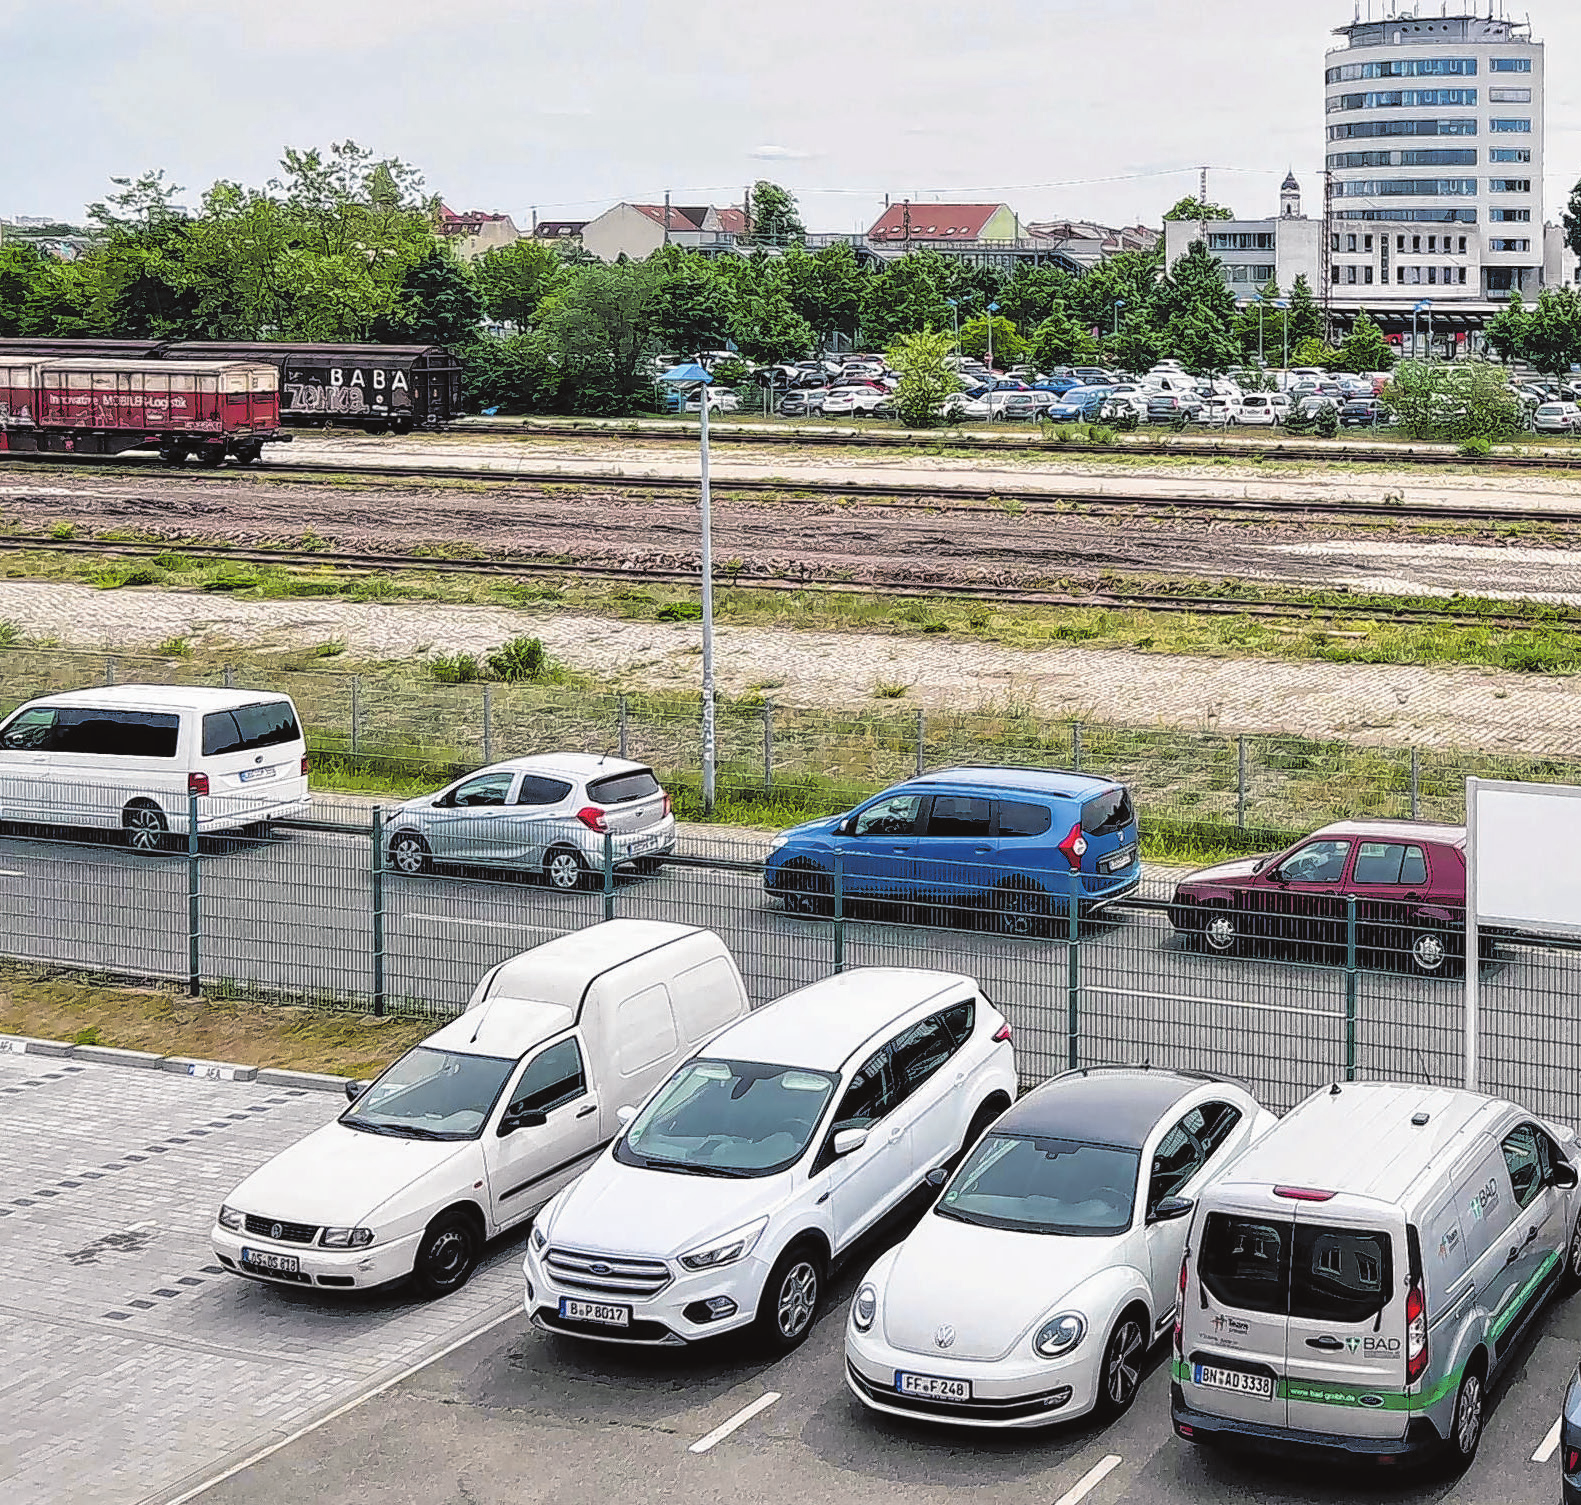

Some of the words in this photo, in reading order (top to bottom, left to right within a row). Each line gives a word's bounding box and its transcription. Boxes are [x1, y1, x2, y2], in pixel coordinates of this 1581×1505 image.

[330, 368, 408, 391] BABA
[585, 1304, 592, 1316] P
[594, 1306, 624, 1320] 8017
[1363, 1337, 1400, 1351] BAD
[906, 1376, 922, 1390] FF
[930, 1380, 938, 1392] F
[941, 1381, 964, 1396] 248
[1203, 1367, 1217, 1383] BN
[1241, 1375, 1269, 1393] 3338
